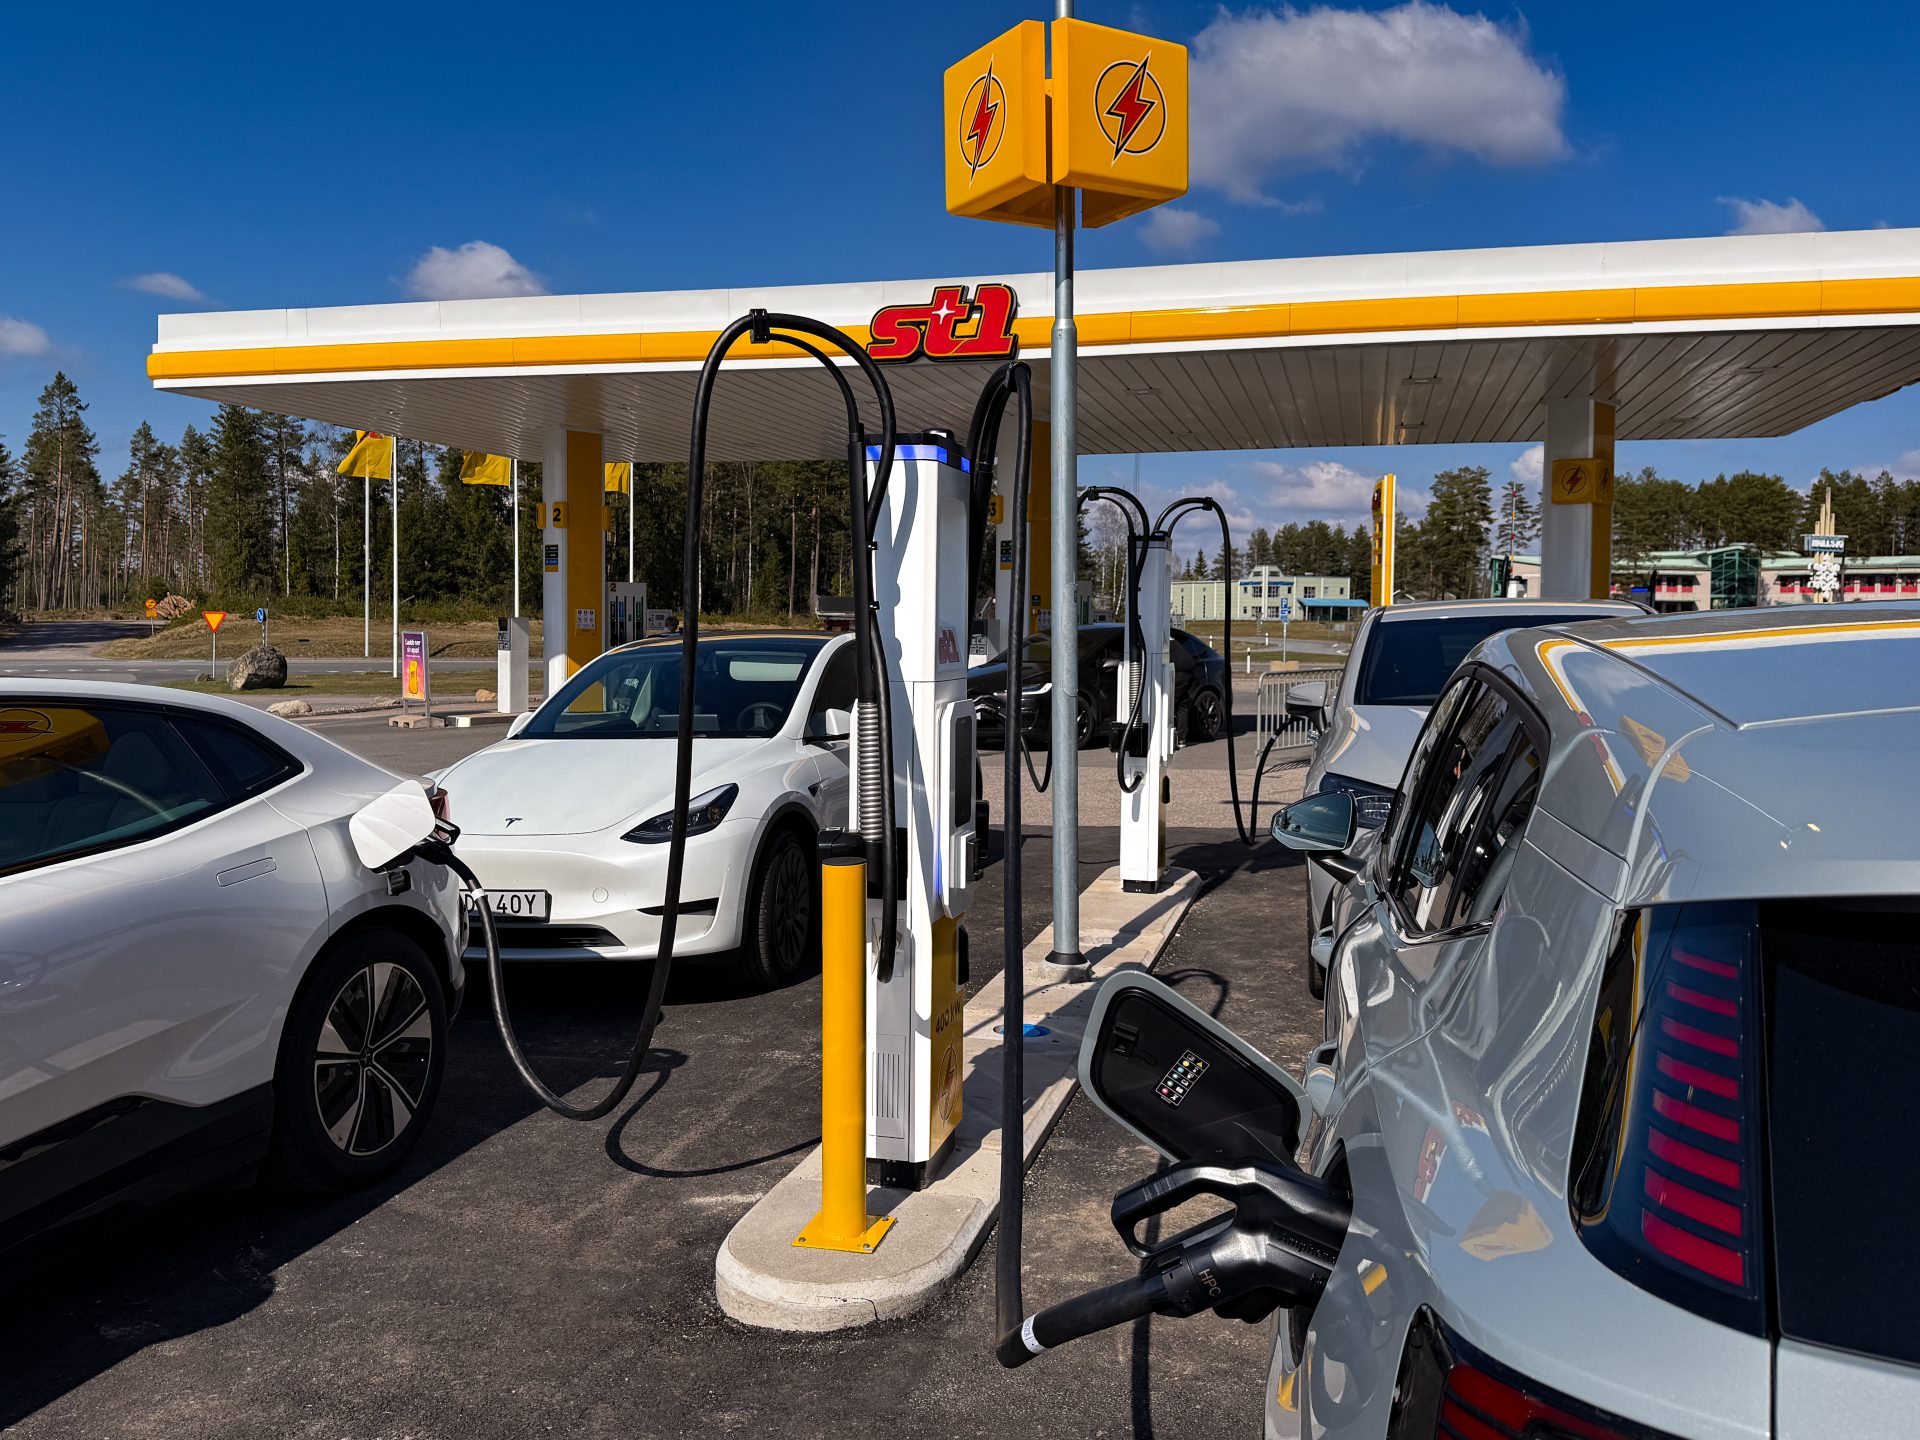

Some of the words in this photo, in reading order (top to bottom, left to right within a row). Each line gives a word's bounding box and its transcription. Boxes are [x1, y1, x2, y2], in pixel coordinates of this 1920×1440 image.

[867, 284, 1018, 364] st1
[553, 508, 561, 521] 2
[611, 583, 617, 592] 2
[935, 1008, 950, 1034] 400
[1199, 1268, 1221, 1297] HPC
